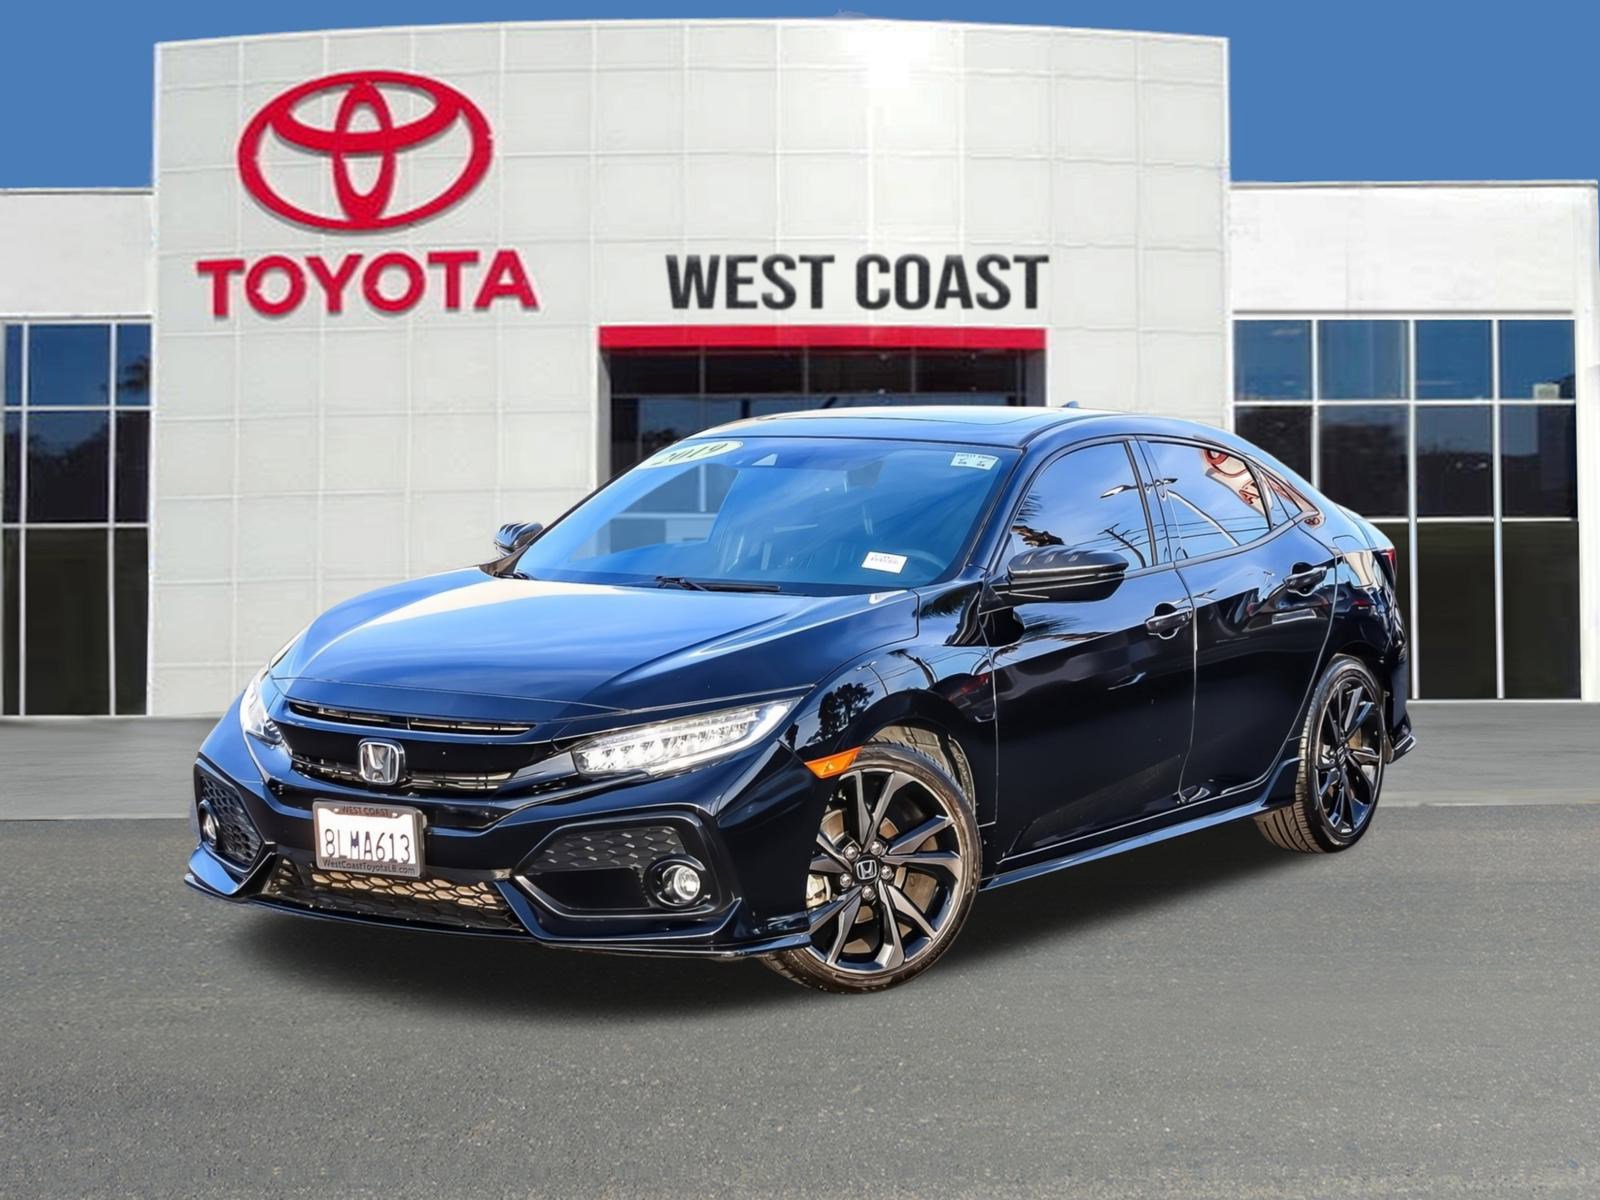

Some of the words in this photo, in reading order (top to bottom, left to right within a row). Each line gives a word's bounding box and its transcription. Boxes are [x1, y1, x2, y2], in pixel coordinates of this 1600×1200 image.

[196, 249, 540, 318] TOYOTA
[665, 253, 835, 311] WEST
[855, 253, 1050, 311] COAST
[324, 828, 411, 864] 8LMA613
